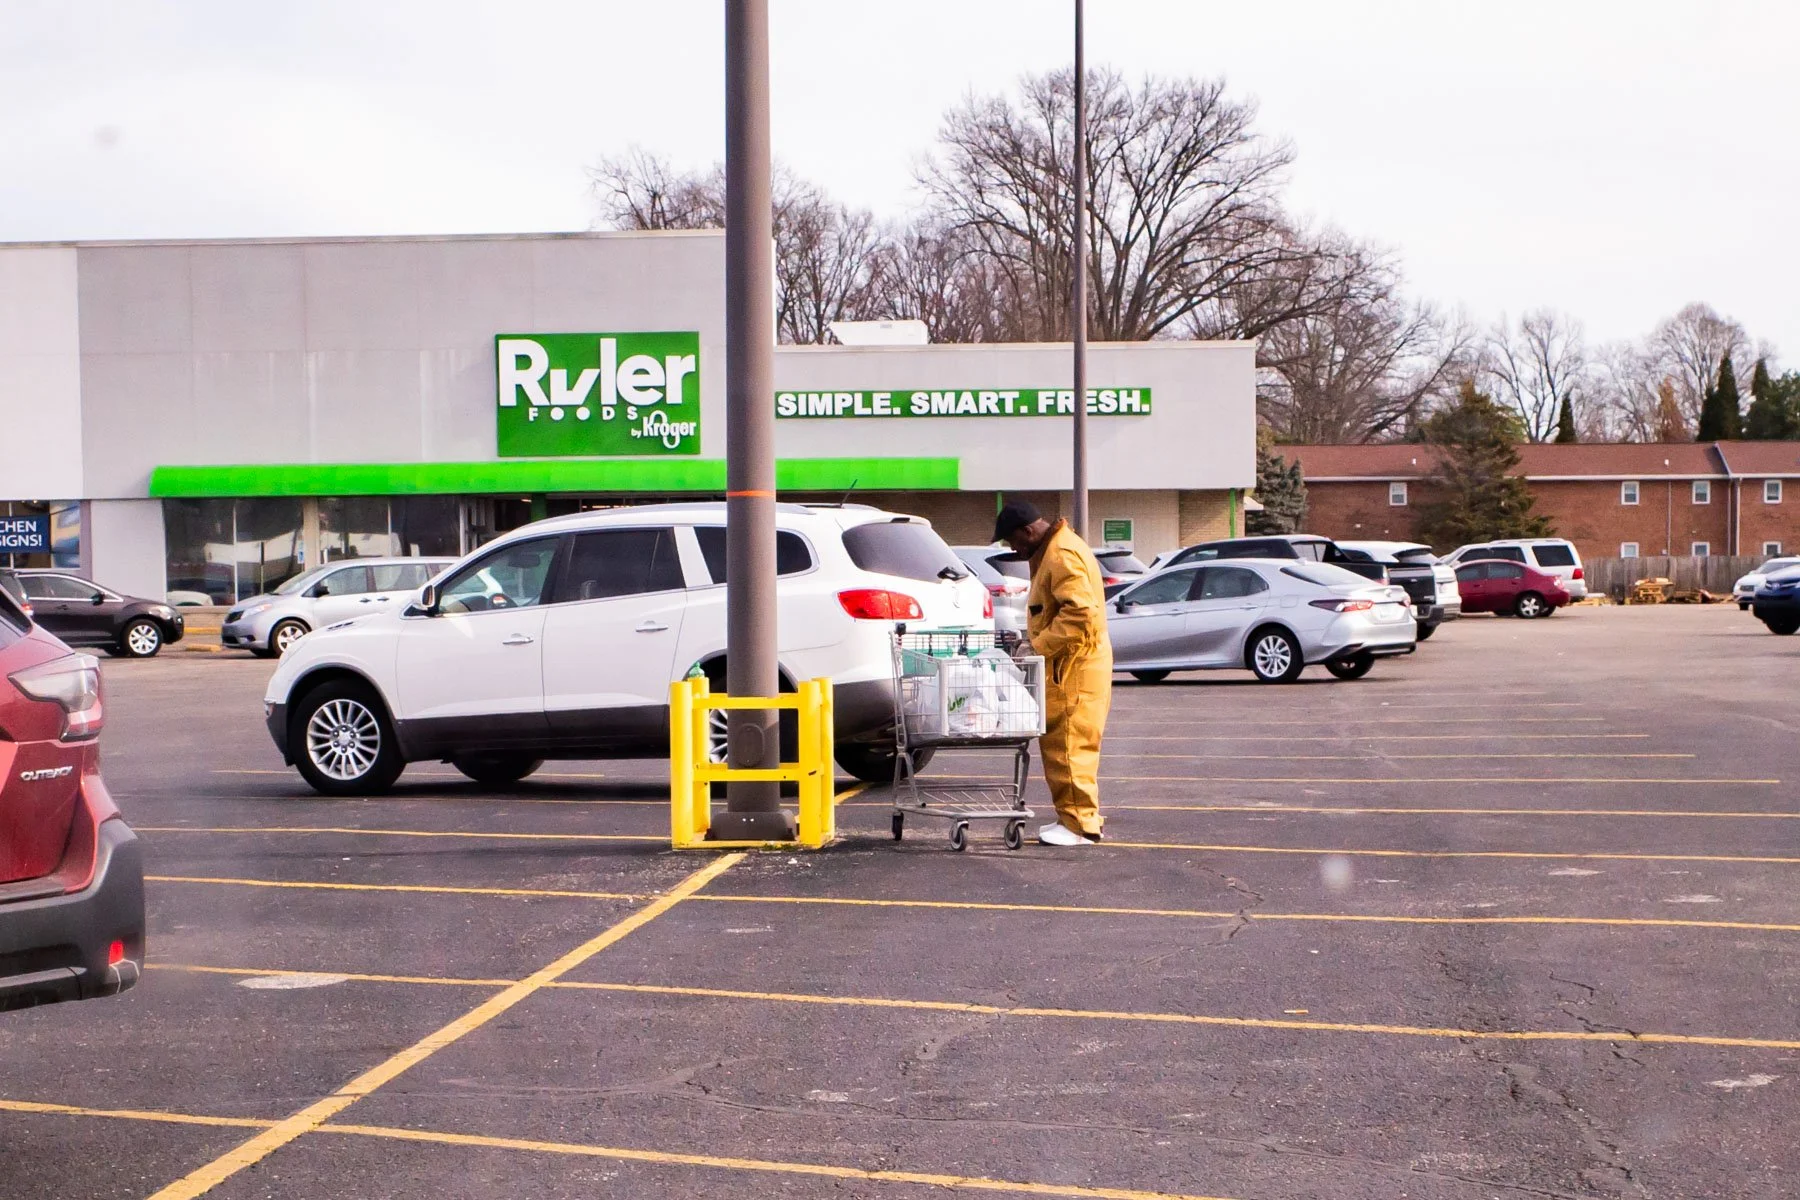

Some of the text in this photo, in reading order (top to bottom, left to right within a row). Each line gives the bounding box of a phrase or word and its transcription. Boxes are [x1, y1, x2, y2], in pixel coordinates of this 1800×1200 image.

[499, 337, 696, 406] Ruler
[528, 406, 638, 421] FOODS
[777, 389, 1150, 416] SIMPLE. SMART. FRESH.
[631, 410, 697, 449] by Kroger
[0, 534, 42, 547] IGNS!
